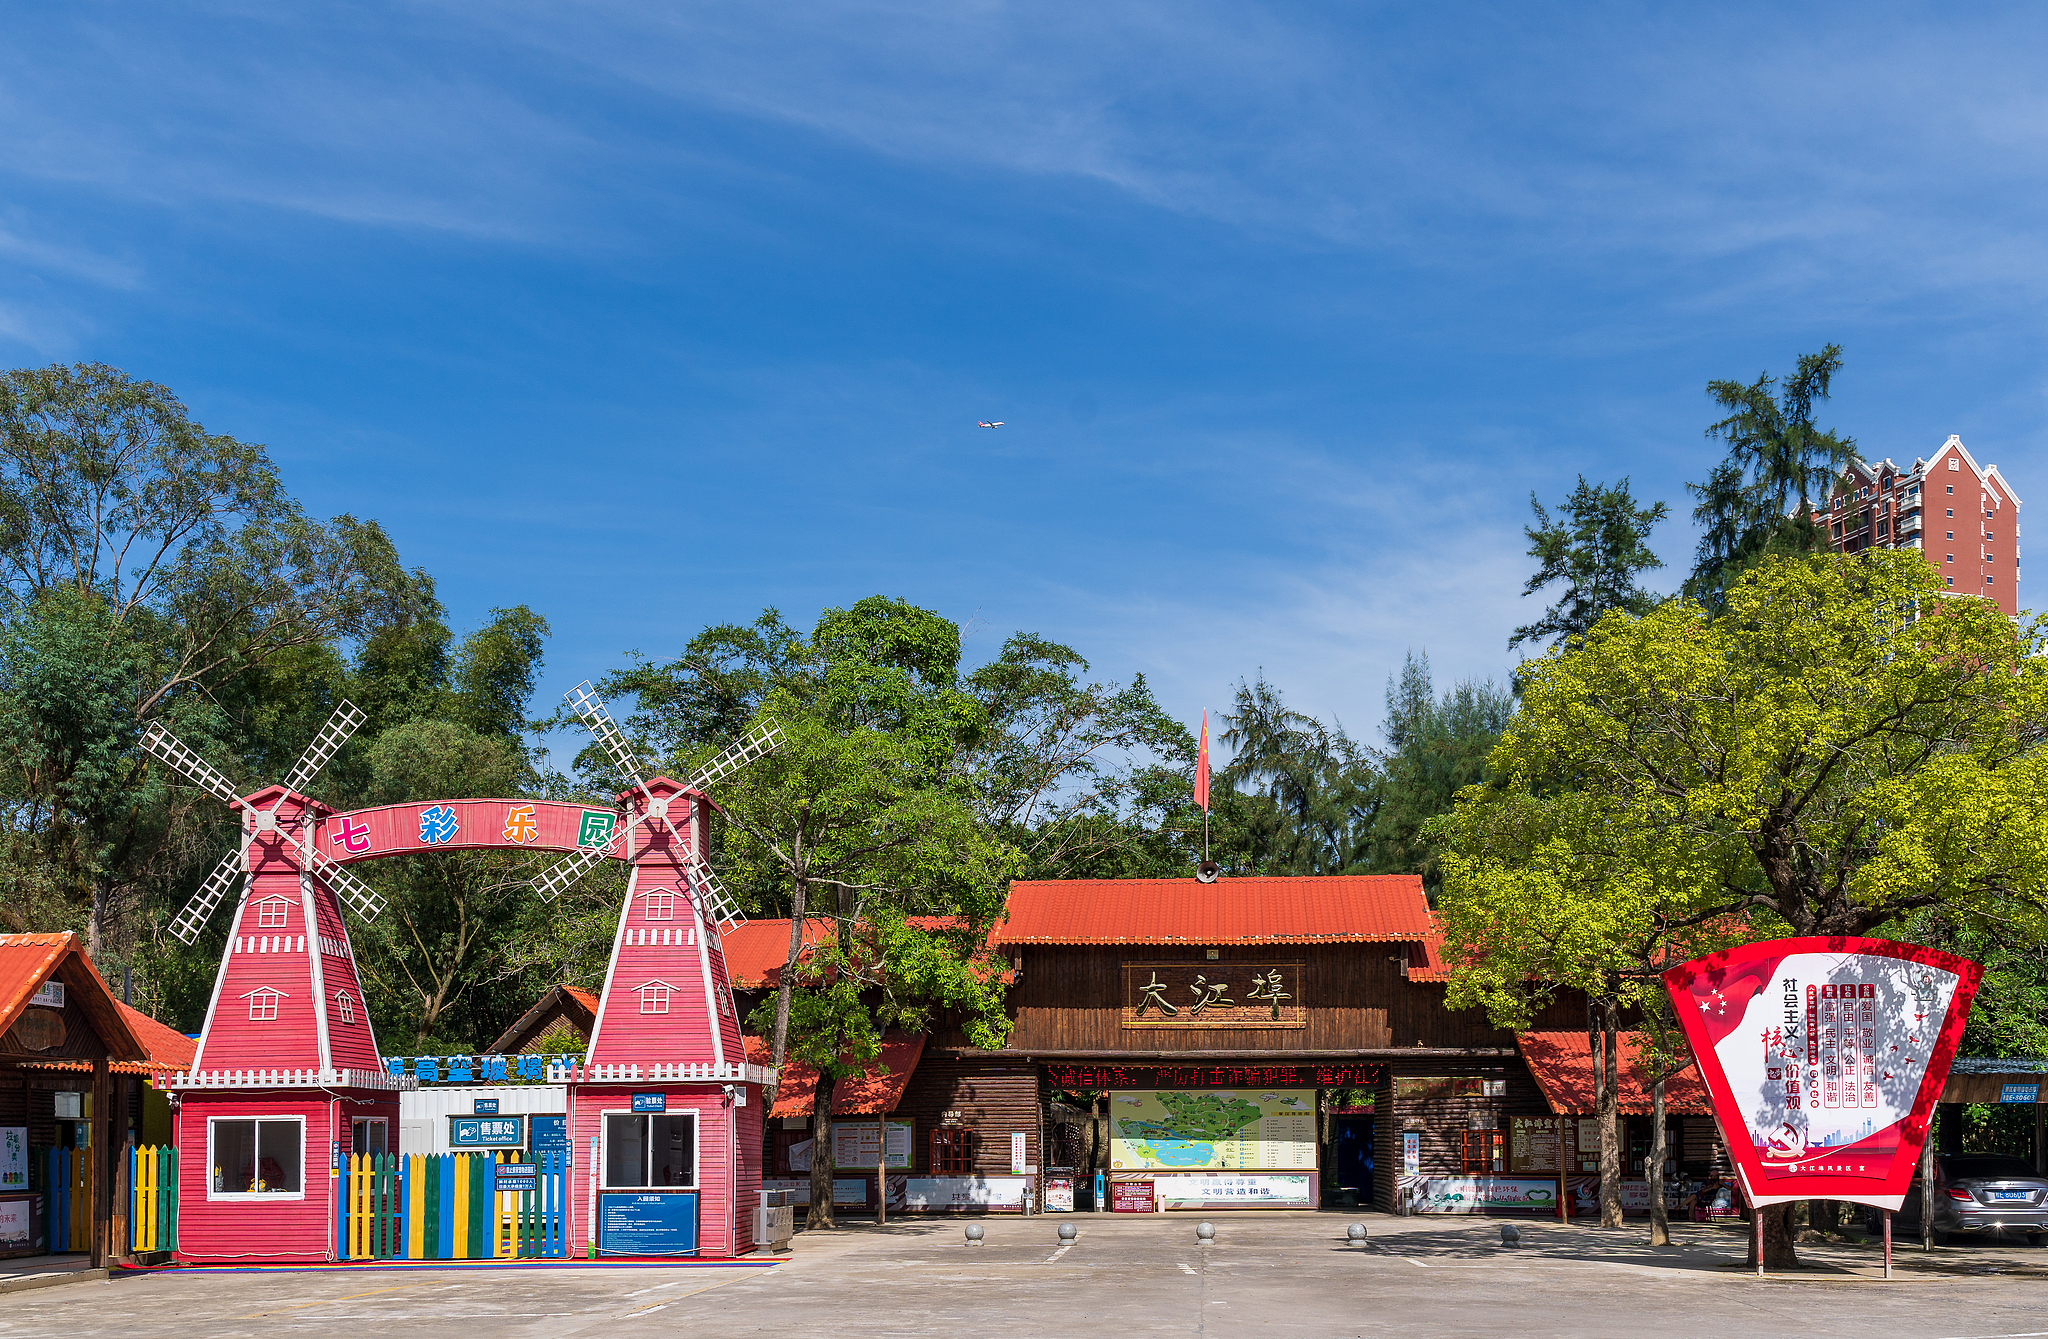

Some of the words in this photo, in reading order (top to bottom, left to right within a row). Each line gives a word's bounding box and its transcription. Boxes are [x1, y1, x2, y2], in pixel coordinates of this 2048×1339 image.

[331, 804, 620, 854] 七彩乐园
[1136, 968, 1293, 1021] 大江埠
[1782, 978, 1800, 1040] 社会主义
[1824, 1001, 1836, 1023] 富强
[1843, 1001, 1854, 1022] 自由
[1861, 1001, 1873, 1022] 爱国
[1825, 1028, 1837, 1049] 民主
[1844, 1028, 1855, 1049] 平等
[1862, 1028, 1874, 1049] 敬业
[1826, 1055, 1838, 1076] 文明
[1844, 1055, 1856, 1076] 公正
[1862, 1055, 1874, 1076] 诚信
[1784, 1063, 1801, 1110] 价值观
[1826, 1081, 1838, 1103] 和谐
[1845, 1081, 1856, 1103] 法治
[1863, 1081, 1875, 1103] 友善
[480, 1121, 515, 1135] 售票处
[1189, 1178, 1258, 1186] 文明赢得尊重
[1201, 1187, 1270, 1196] 文明营造和谐
